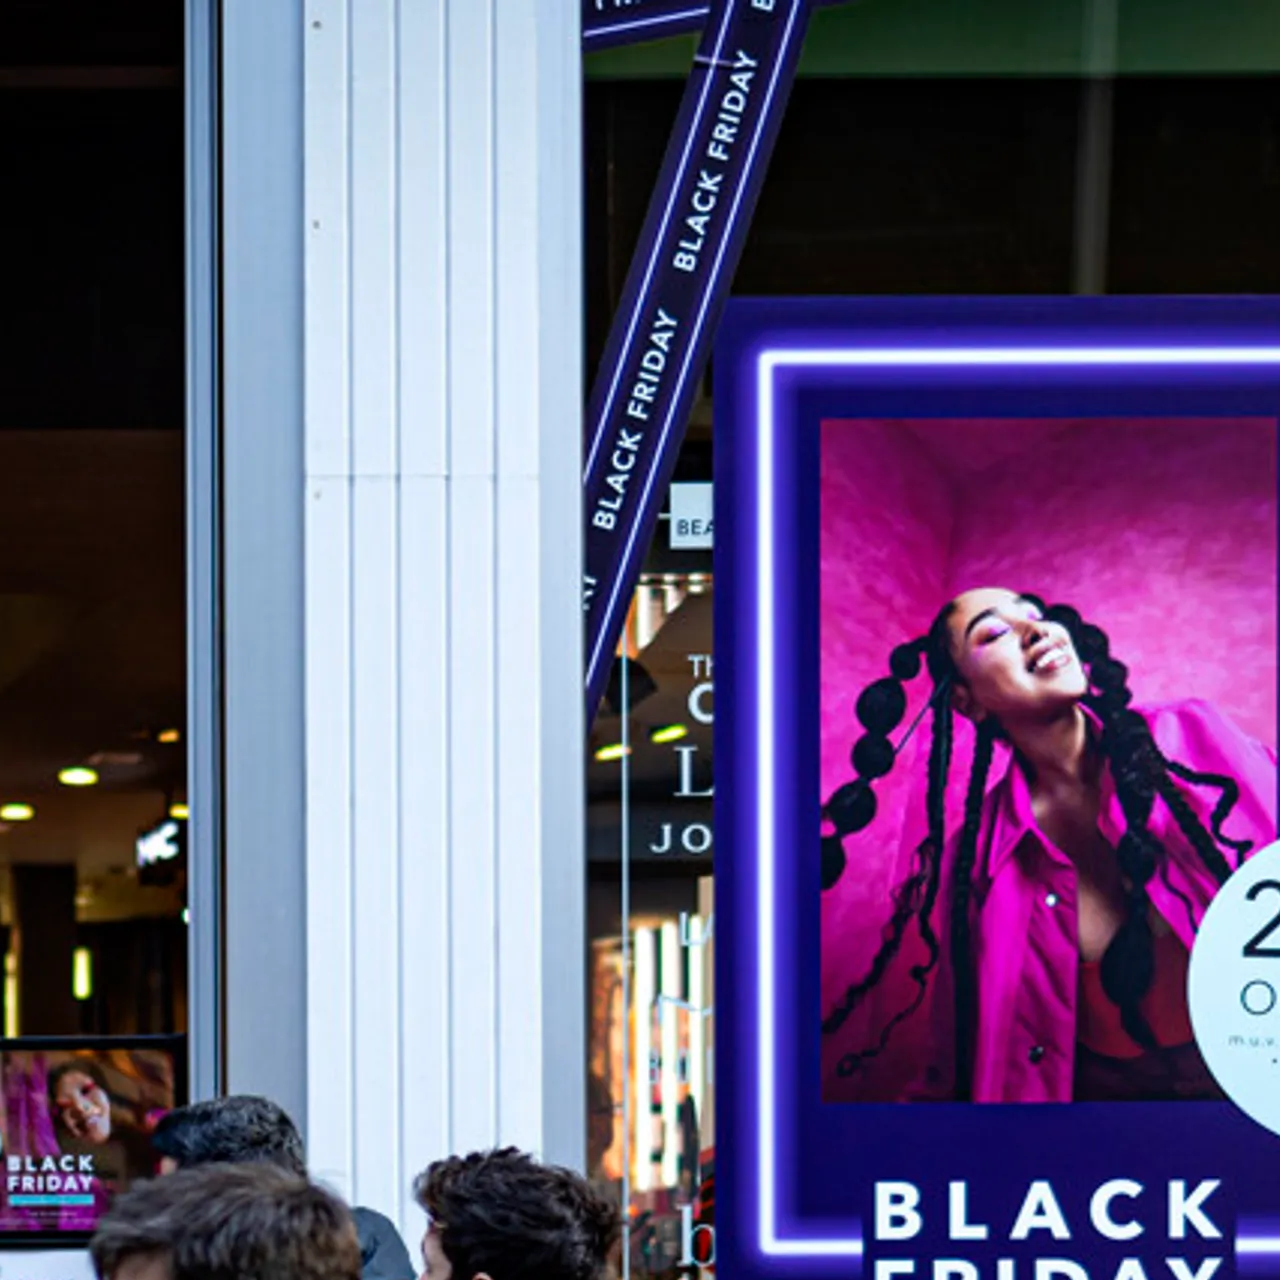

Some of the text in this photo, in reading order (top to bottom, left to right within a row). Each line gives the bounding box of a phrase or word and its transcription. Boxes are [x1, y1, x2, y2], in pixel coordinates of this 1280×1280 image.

[673, 50, 759, 272] BLACK FRIDAY
[592, 308, 678, 531] BLACK FRIDAY
[7, 1154, 94, 1172] BLACK
[7, 1174, 94, 1192] FRIDAY
[874, 1178, 1223, 1240] BLACK
